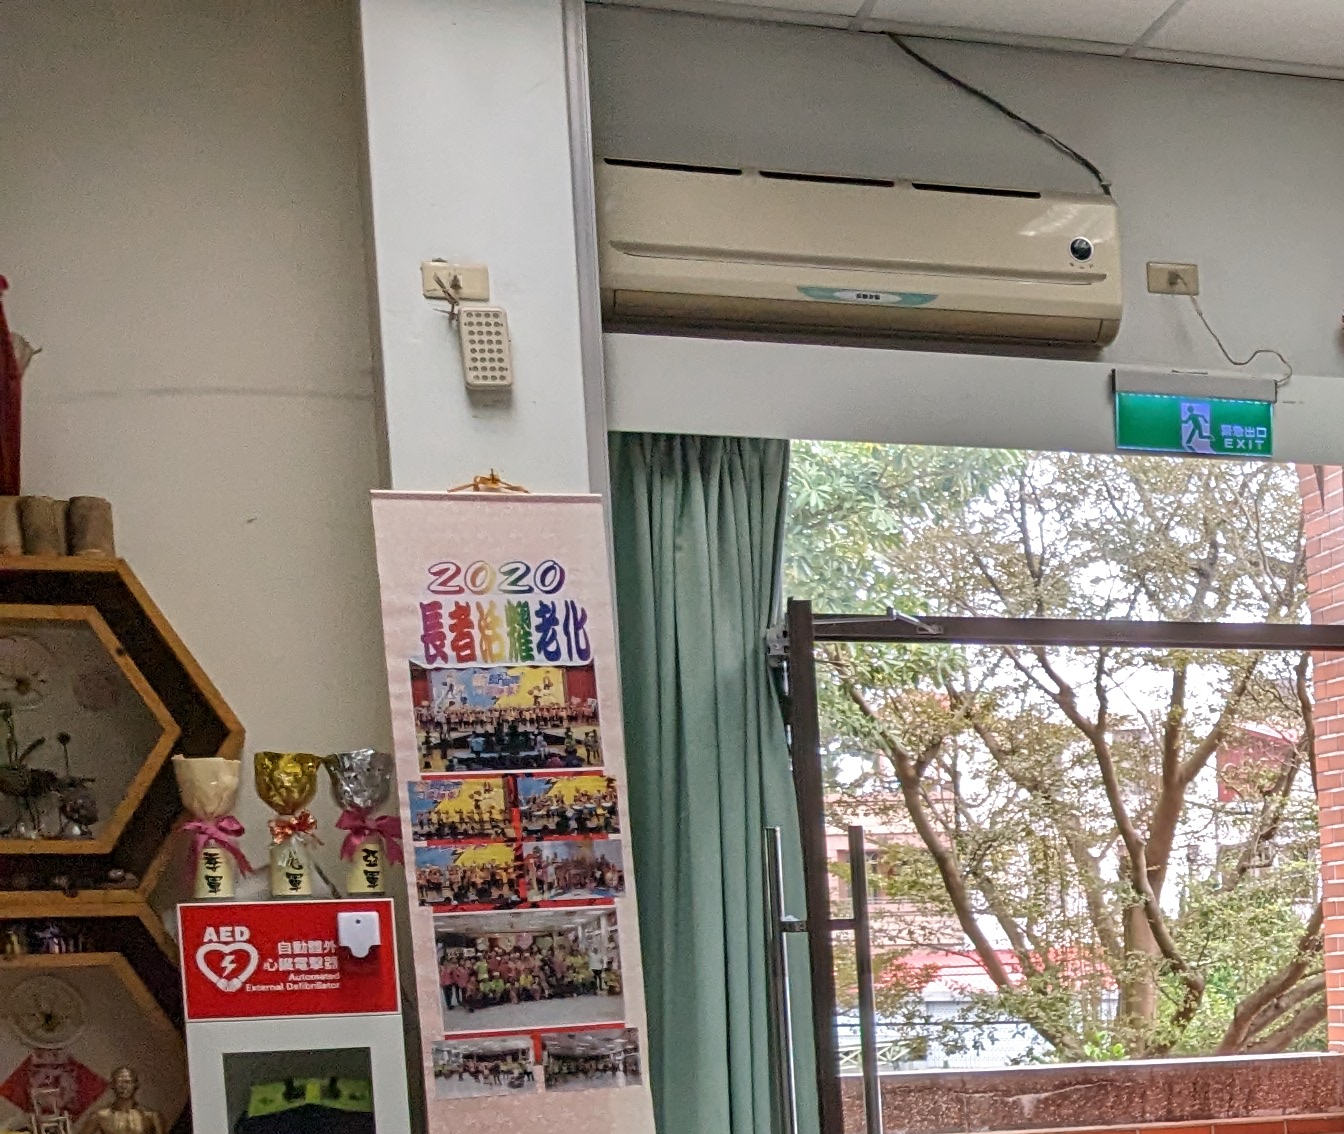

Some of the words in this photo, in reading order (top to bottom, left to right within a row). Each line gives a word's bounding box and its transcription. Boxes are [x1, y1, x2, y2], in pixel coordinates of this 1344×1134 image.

[1224, 438, 1264, 449] EXIT
[427, 559, 565, 595] 2020
[203, 926, 250, 943] AED
[278, 940, 337, 955] 自動體外
[263, 956, 339, 972] 心臟電擊器
[288, 973, 341, 982] Automated
[246, 983, 284, 992] External
[286, 982, 340, 991] Defibrillator
